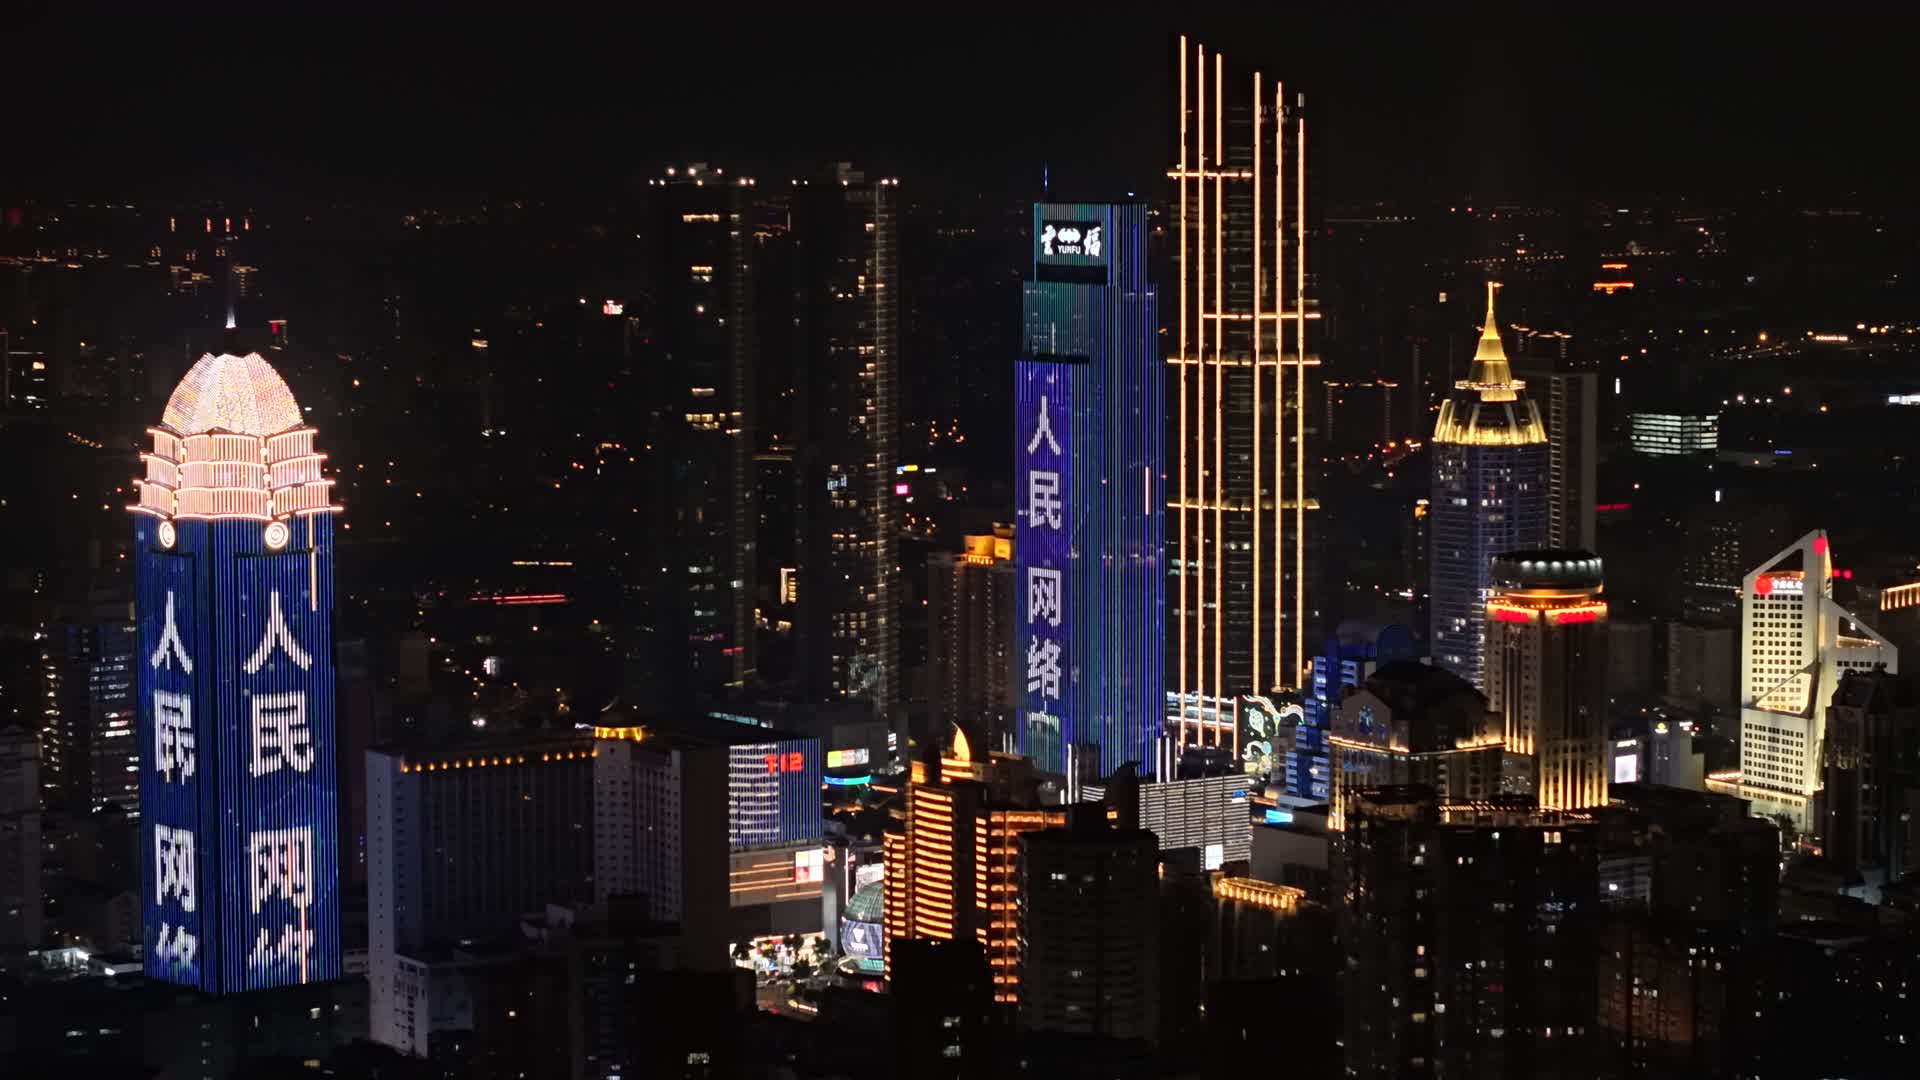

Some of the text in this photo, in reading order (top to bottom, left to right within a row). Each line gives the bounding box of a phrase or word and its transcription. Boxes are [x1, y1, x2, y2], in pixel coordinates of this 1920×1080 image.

[1058, 245, 1081, 255] YUNFU
[1027, 395, 1062, 700] 人民网络
